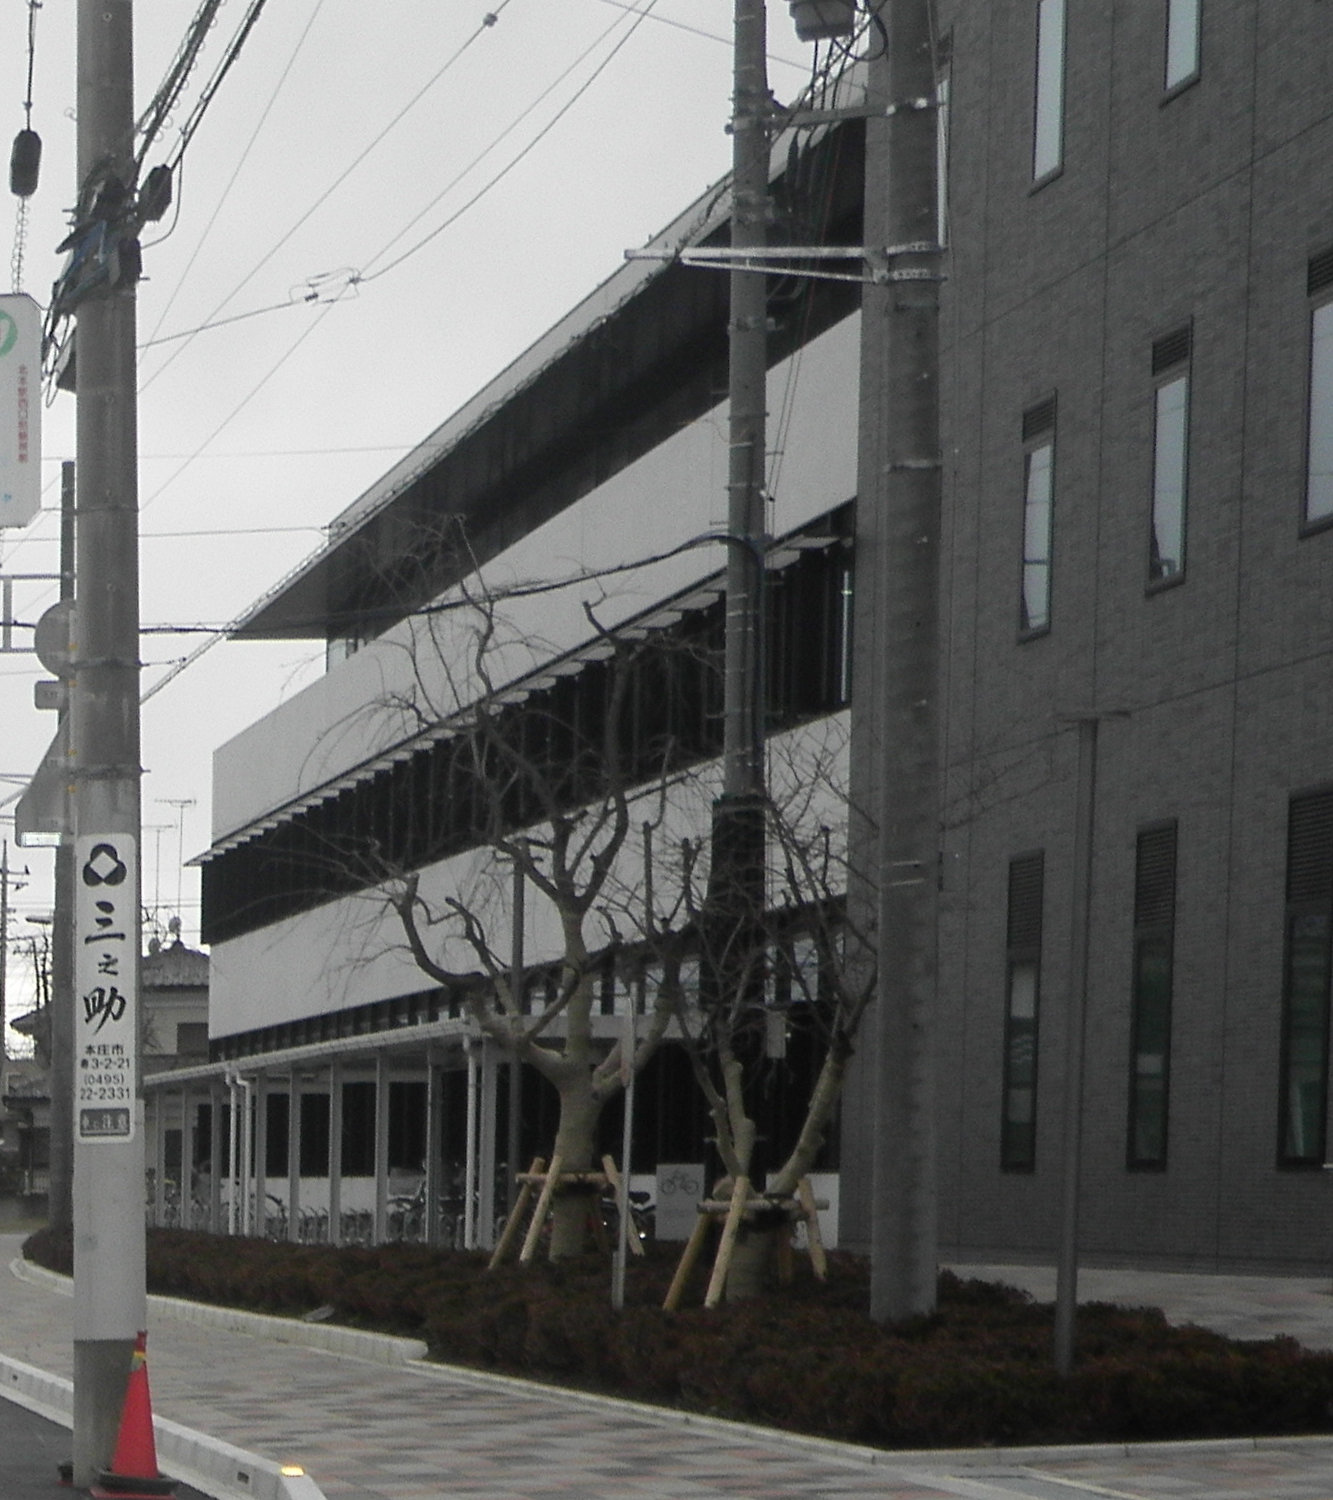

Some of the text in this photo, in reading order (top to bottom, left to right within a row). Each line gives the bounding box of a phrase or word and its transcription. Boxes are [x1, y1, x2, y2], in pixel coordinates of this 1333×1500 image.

[83, 901, 127, 1037] 三之助
[85, 1044, 125, 1056] 本庄市
[84, 1073, 125, 1086] (0495)
[80, 1087, 131, 1101] 22-2331
